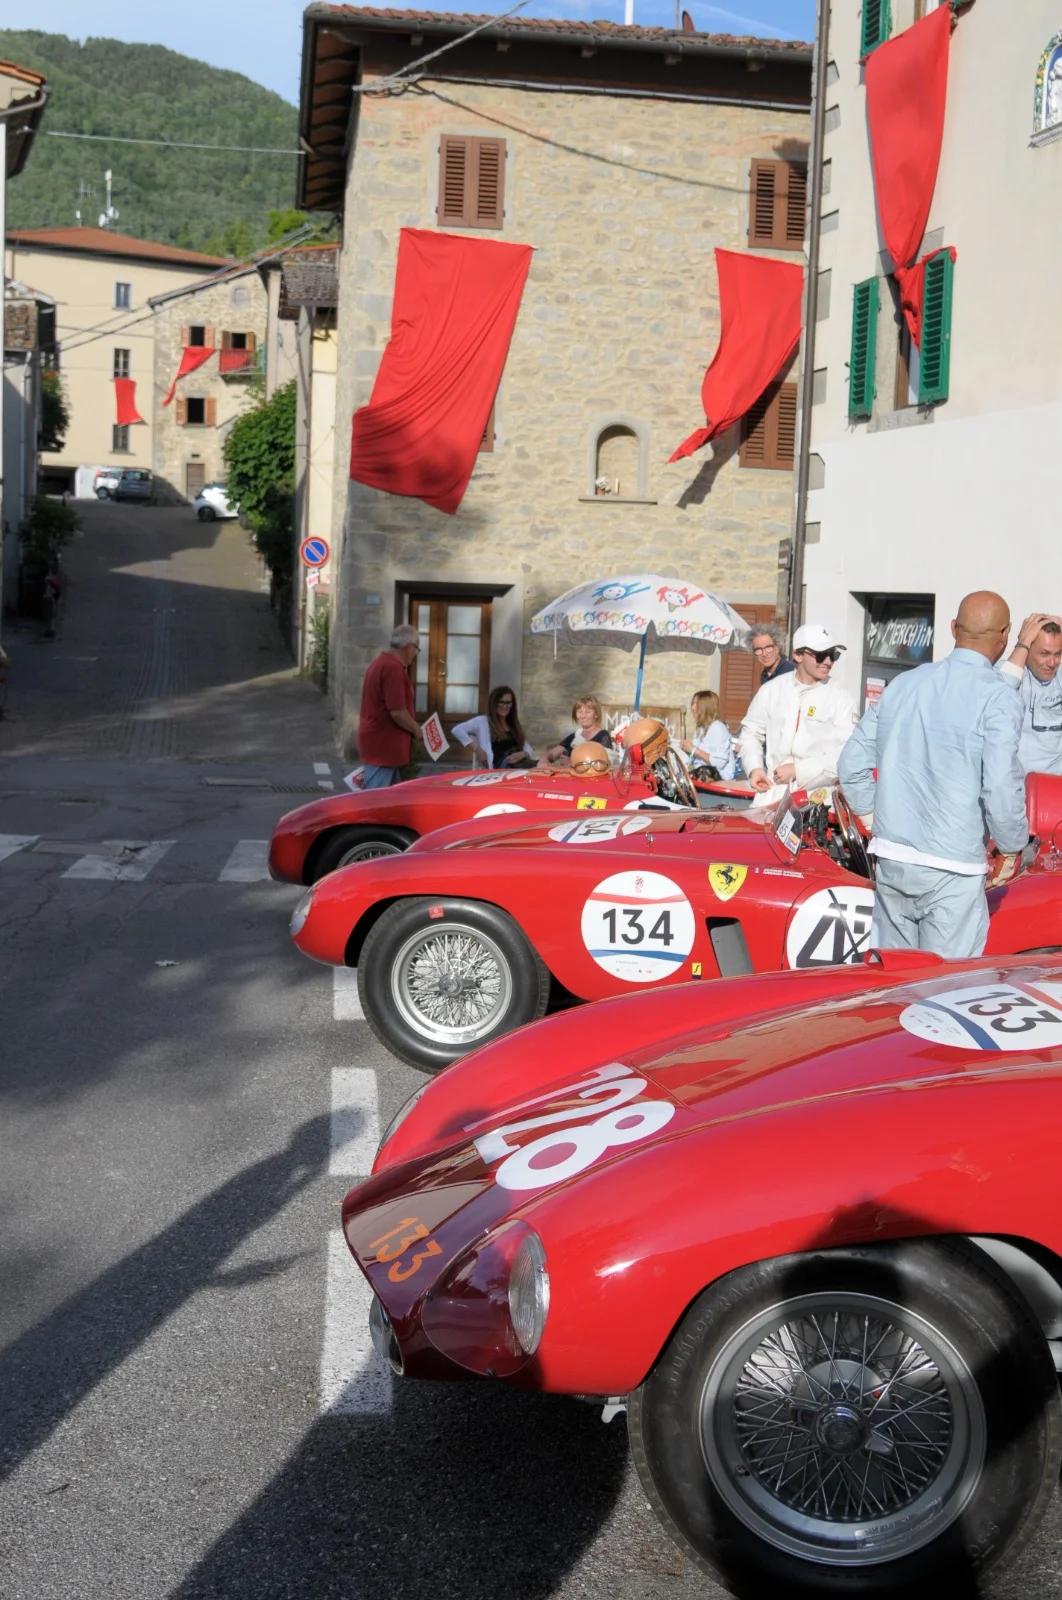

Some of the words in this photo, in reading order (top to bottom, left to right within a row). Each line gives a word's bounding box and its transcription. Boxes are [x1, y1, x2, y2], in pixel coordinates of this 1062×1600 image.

[602, 908, 674, 946] 134
[954, 991, 1062, 1033] 133
[369, 1217, 443, 1283] 133
